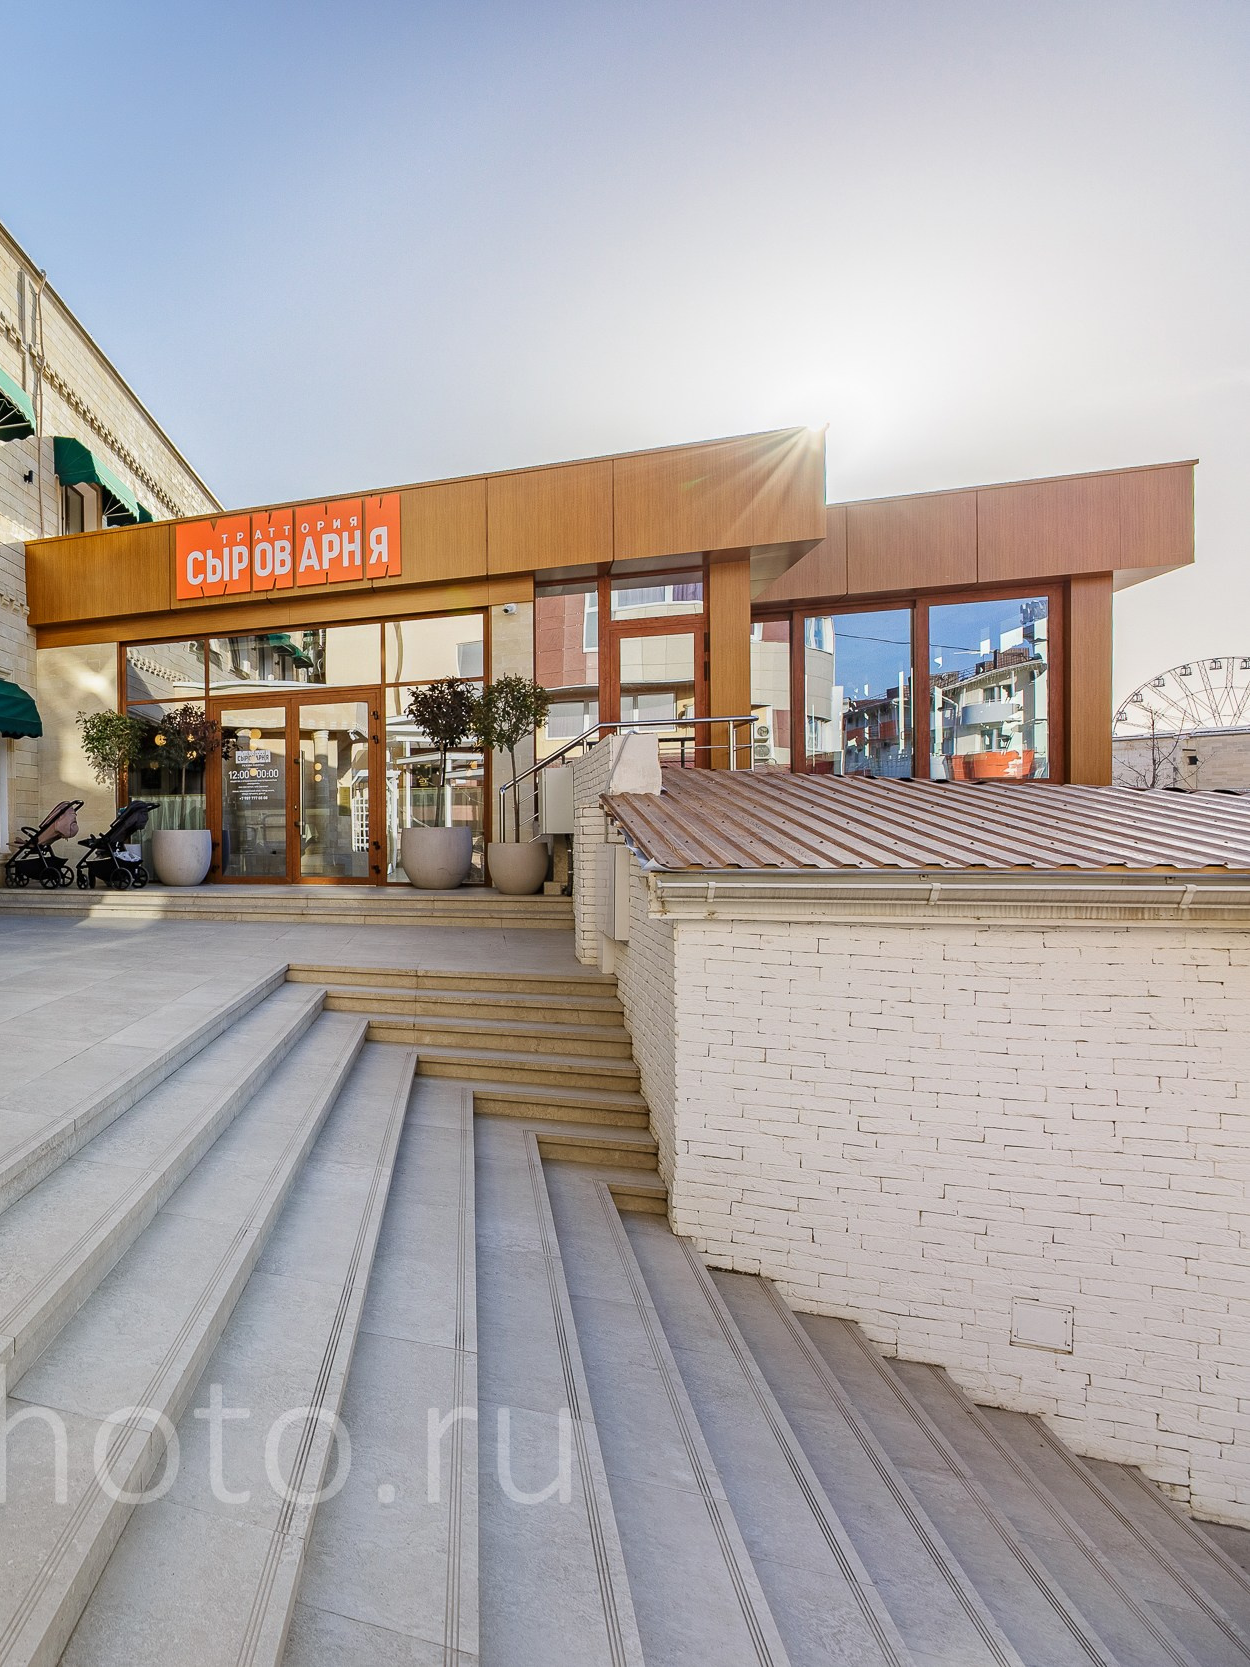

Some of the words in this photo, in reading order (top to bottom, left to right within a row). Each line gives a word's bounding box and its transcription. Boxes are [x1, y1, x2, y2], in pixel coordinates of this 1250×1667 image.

[221, 515, 358, 544] ТРАТТОРИЯ
[186, 525, 389, 586] СЫРОВАРНЯ
[228, 770, 249, 779] 12:00
[256, 769, 279, 778] 00:00
